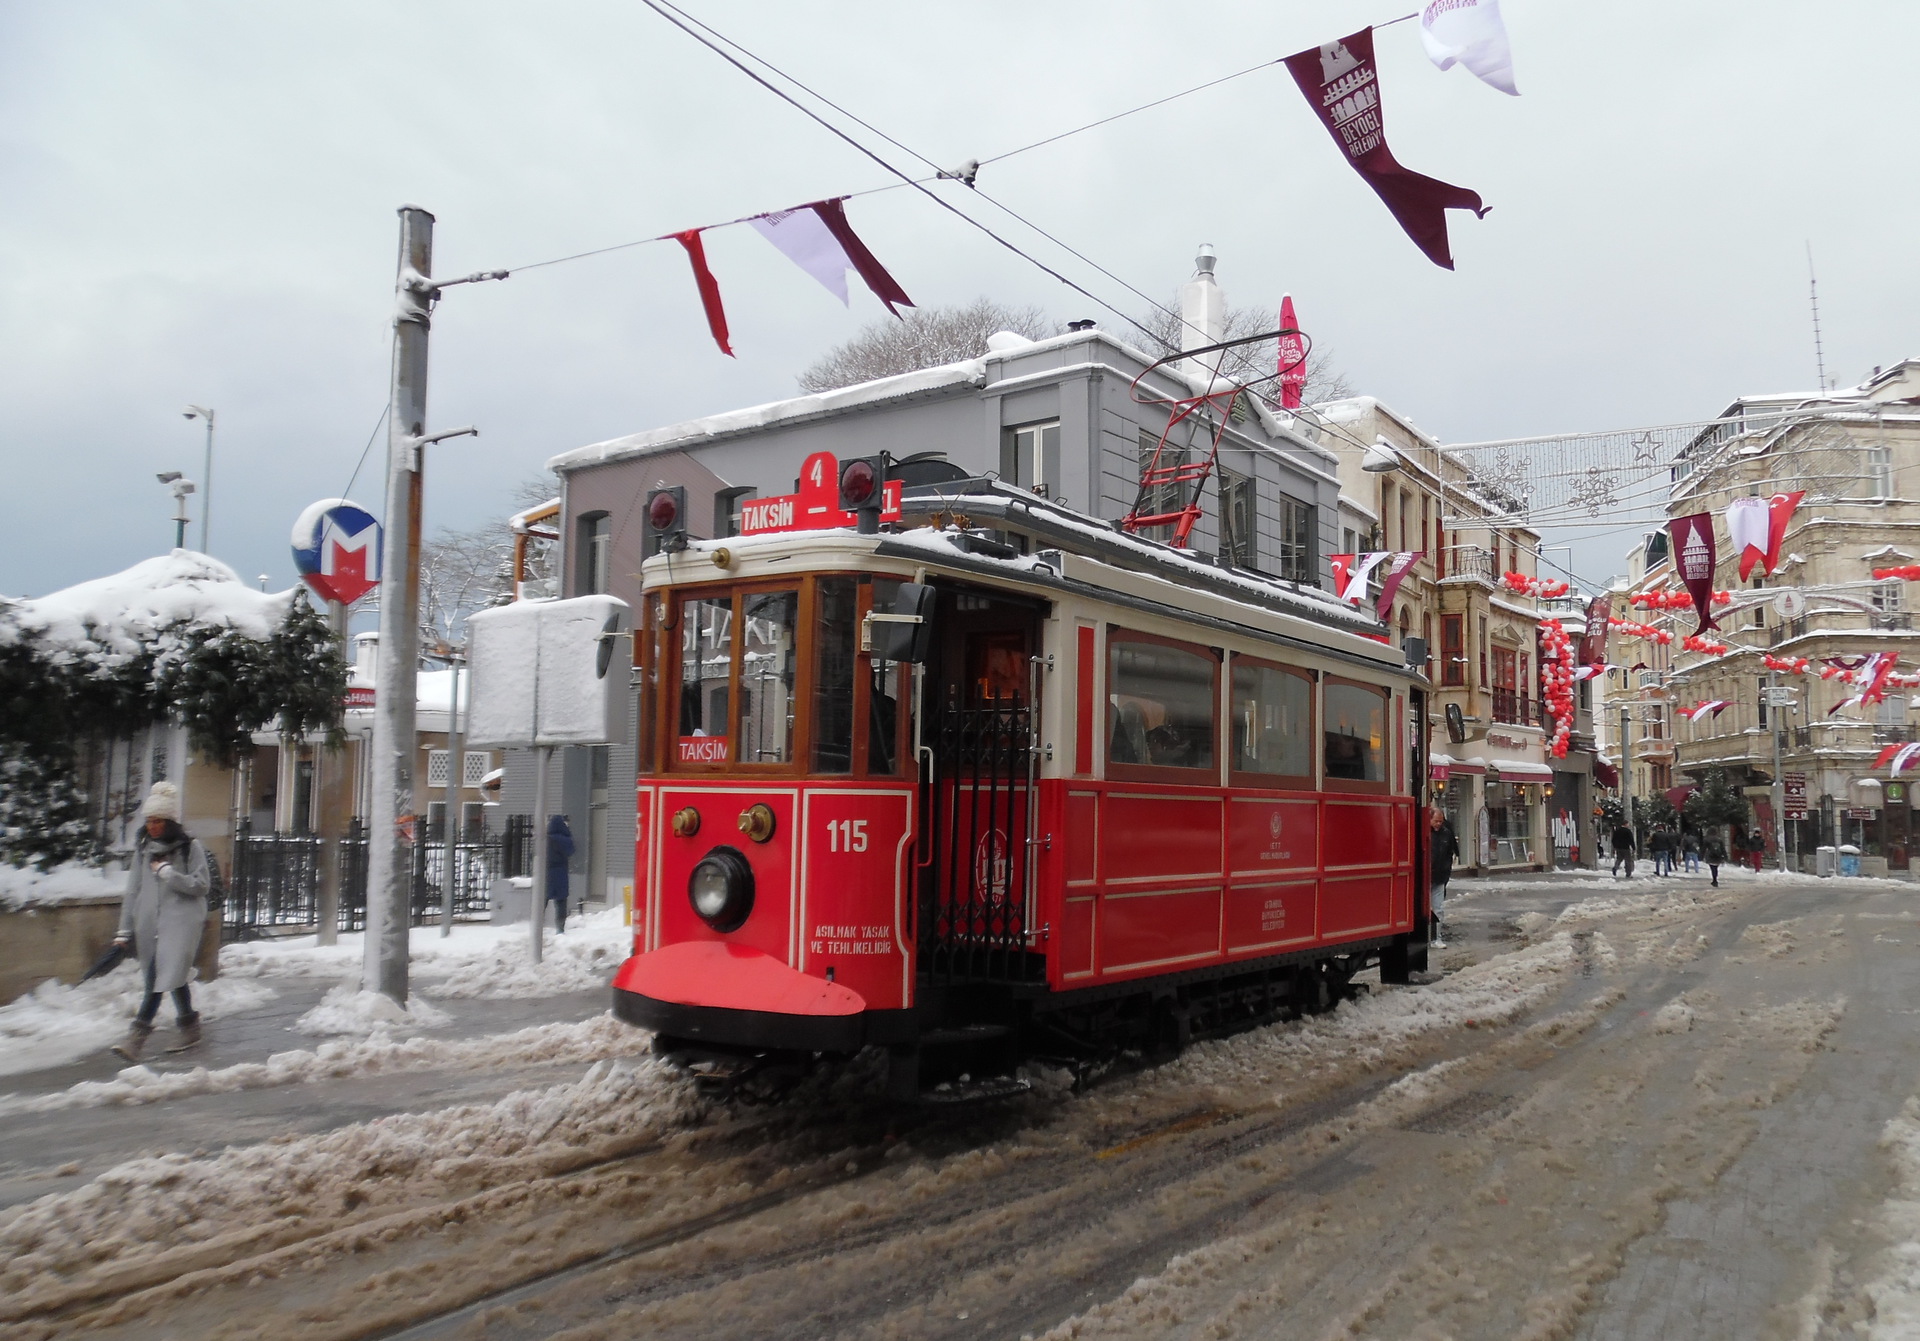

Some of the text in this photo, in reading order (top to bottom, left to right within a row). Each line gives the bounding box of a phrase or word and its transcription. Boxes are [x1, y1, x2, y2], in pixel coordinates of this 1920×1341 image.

[810, 459, 822, 487] 4
[742, 498, 793, 531] TAKSİM
[826, 819, 868, 853] 115
[815, 925, 890, 938] ASILMAK YASAK
[811, 940, 892, 955] VE TEHLİKELİDİR
